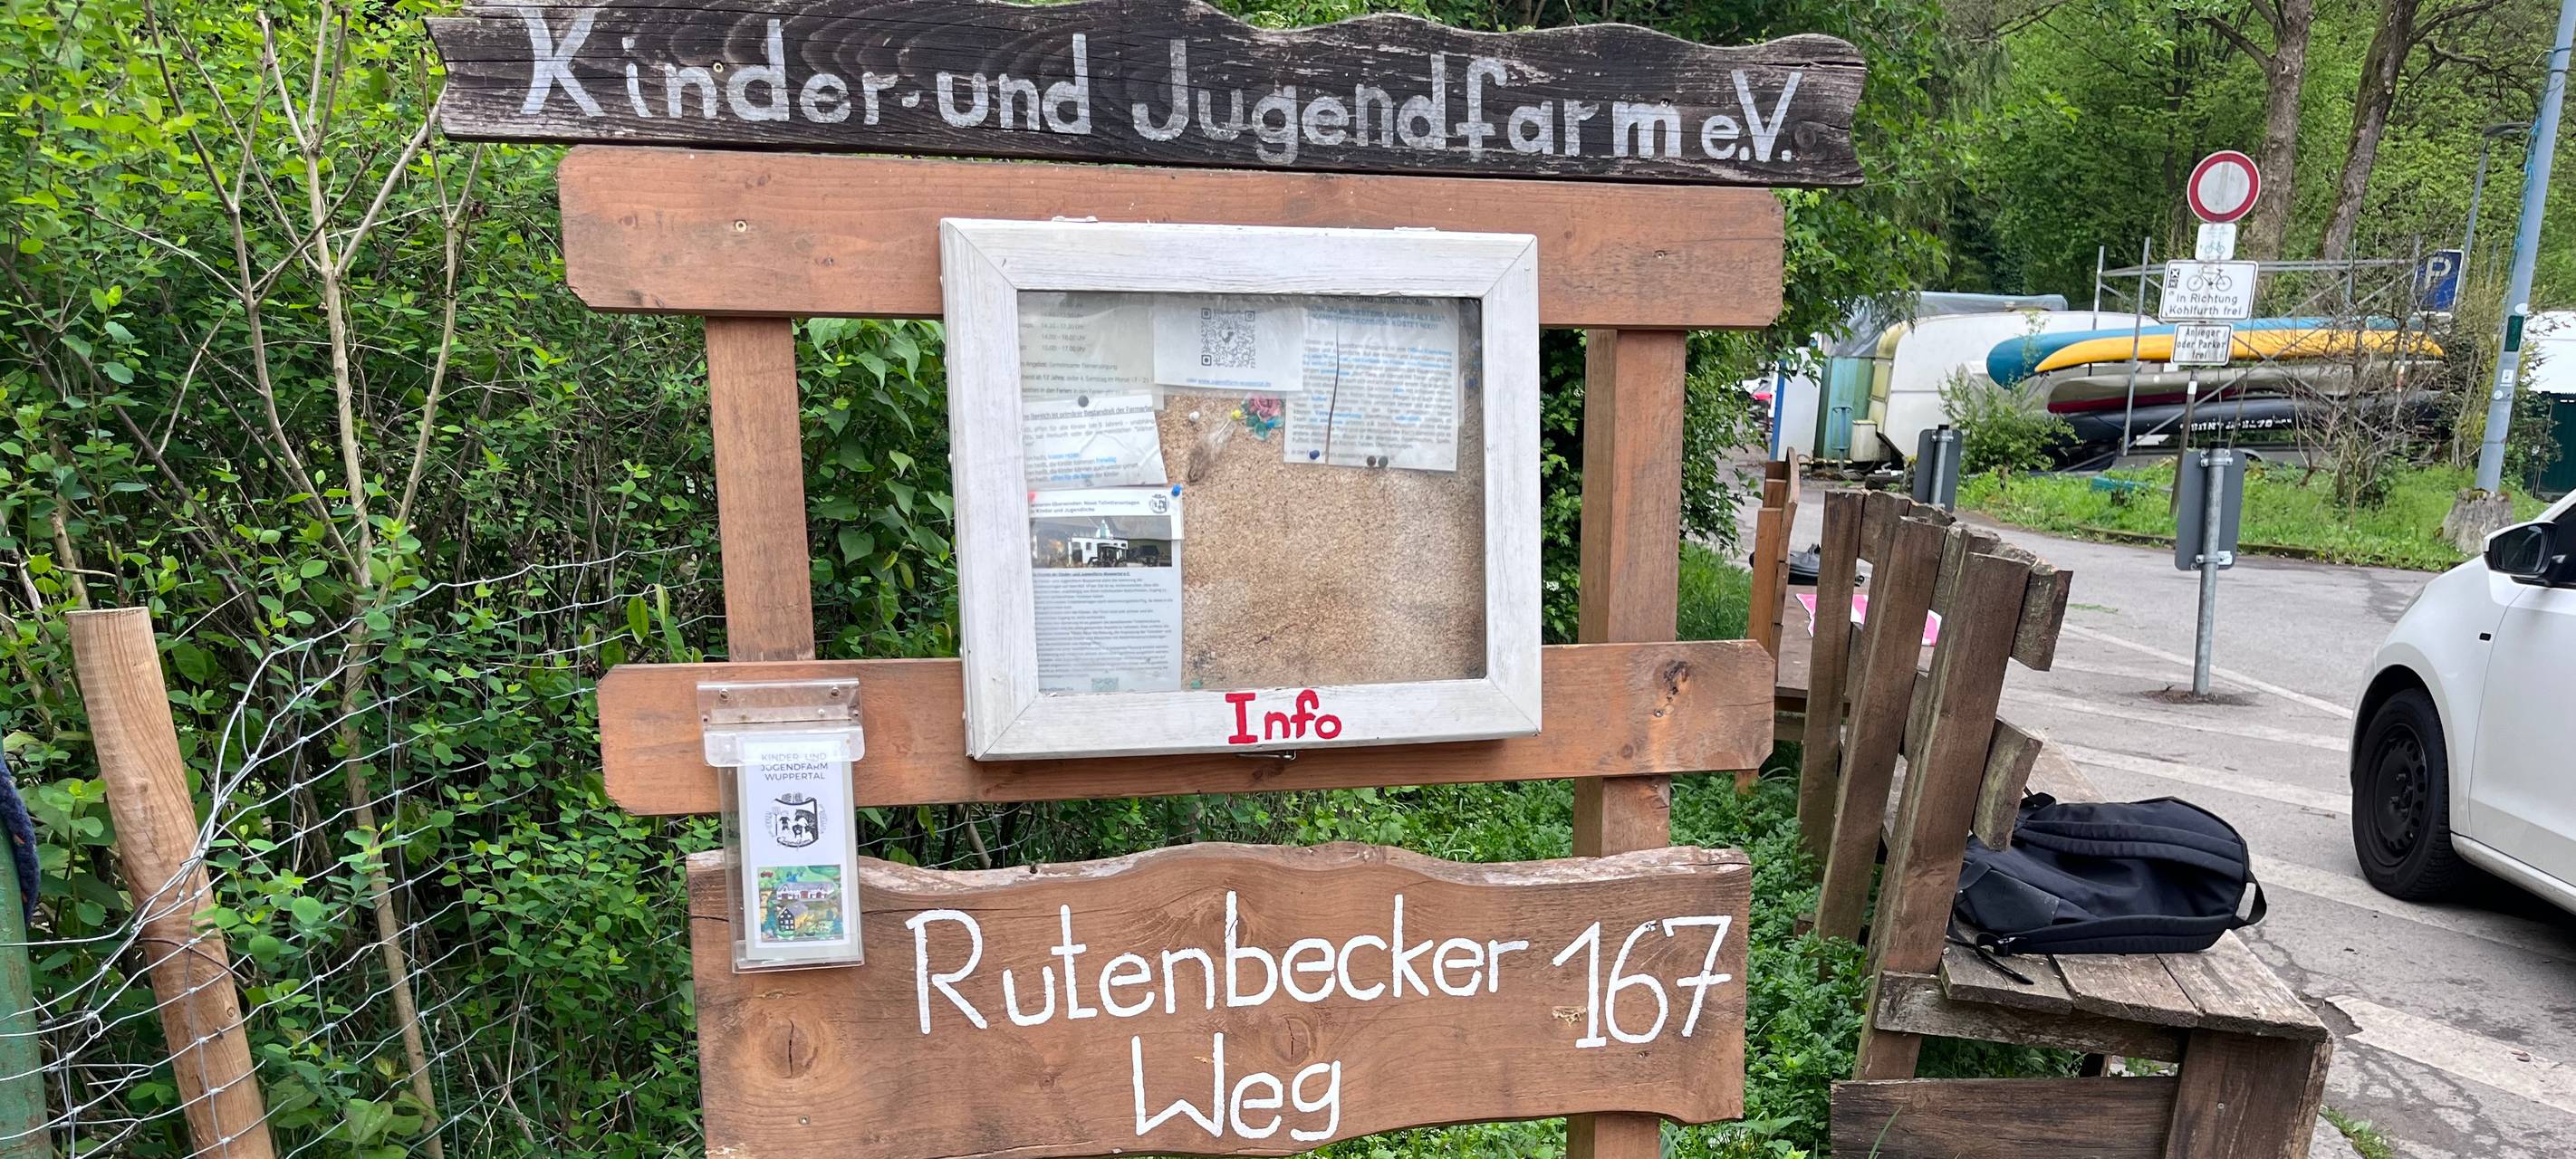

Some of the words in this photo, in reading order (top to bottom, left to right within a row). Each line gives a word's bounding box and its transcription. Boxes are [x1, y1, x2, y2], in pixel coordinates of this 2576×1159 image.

[1132, 39, 1682, 166] Jugendfarm
[1702, 69, 1802, 163] e.V.
[2425, 256, 2451, 291] P
[2190, 292, 2238, 306] Richtung
[2169, 305, 2219, 315] Kohlfurth
[2224, 306, 2242, 316] frei
[2185, 327, 2222, 340] Anlieger
[2177, 340, 2196, 349] oder
[2198, 339, 2227, 349] Parker
[2192, 350, 2208, 359] frei
[1226, 689, 1342, 744] Info
[805, 752, 827, 761] UND
[764, 771, 826, 781] WUPPERTAL
[905, 890, 1529, 1035] Rutenbecker
[1552, 915, 1732, 1049] 167
[1131, 1032, 1341, 1142] Weg
